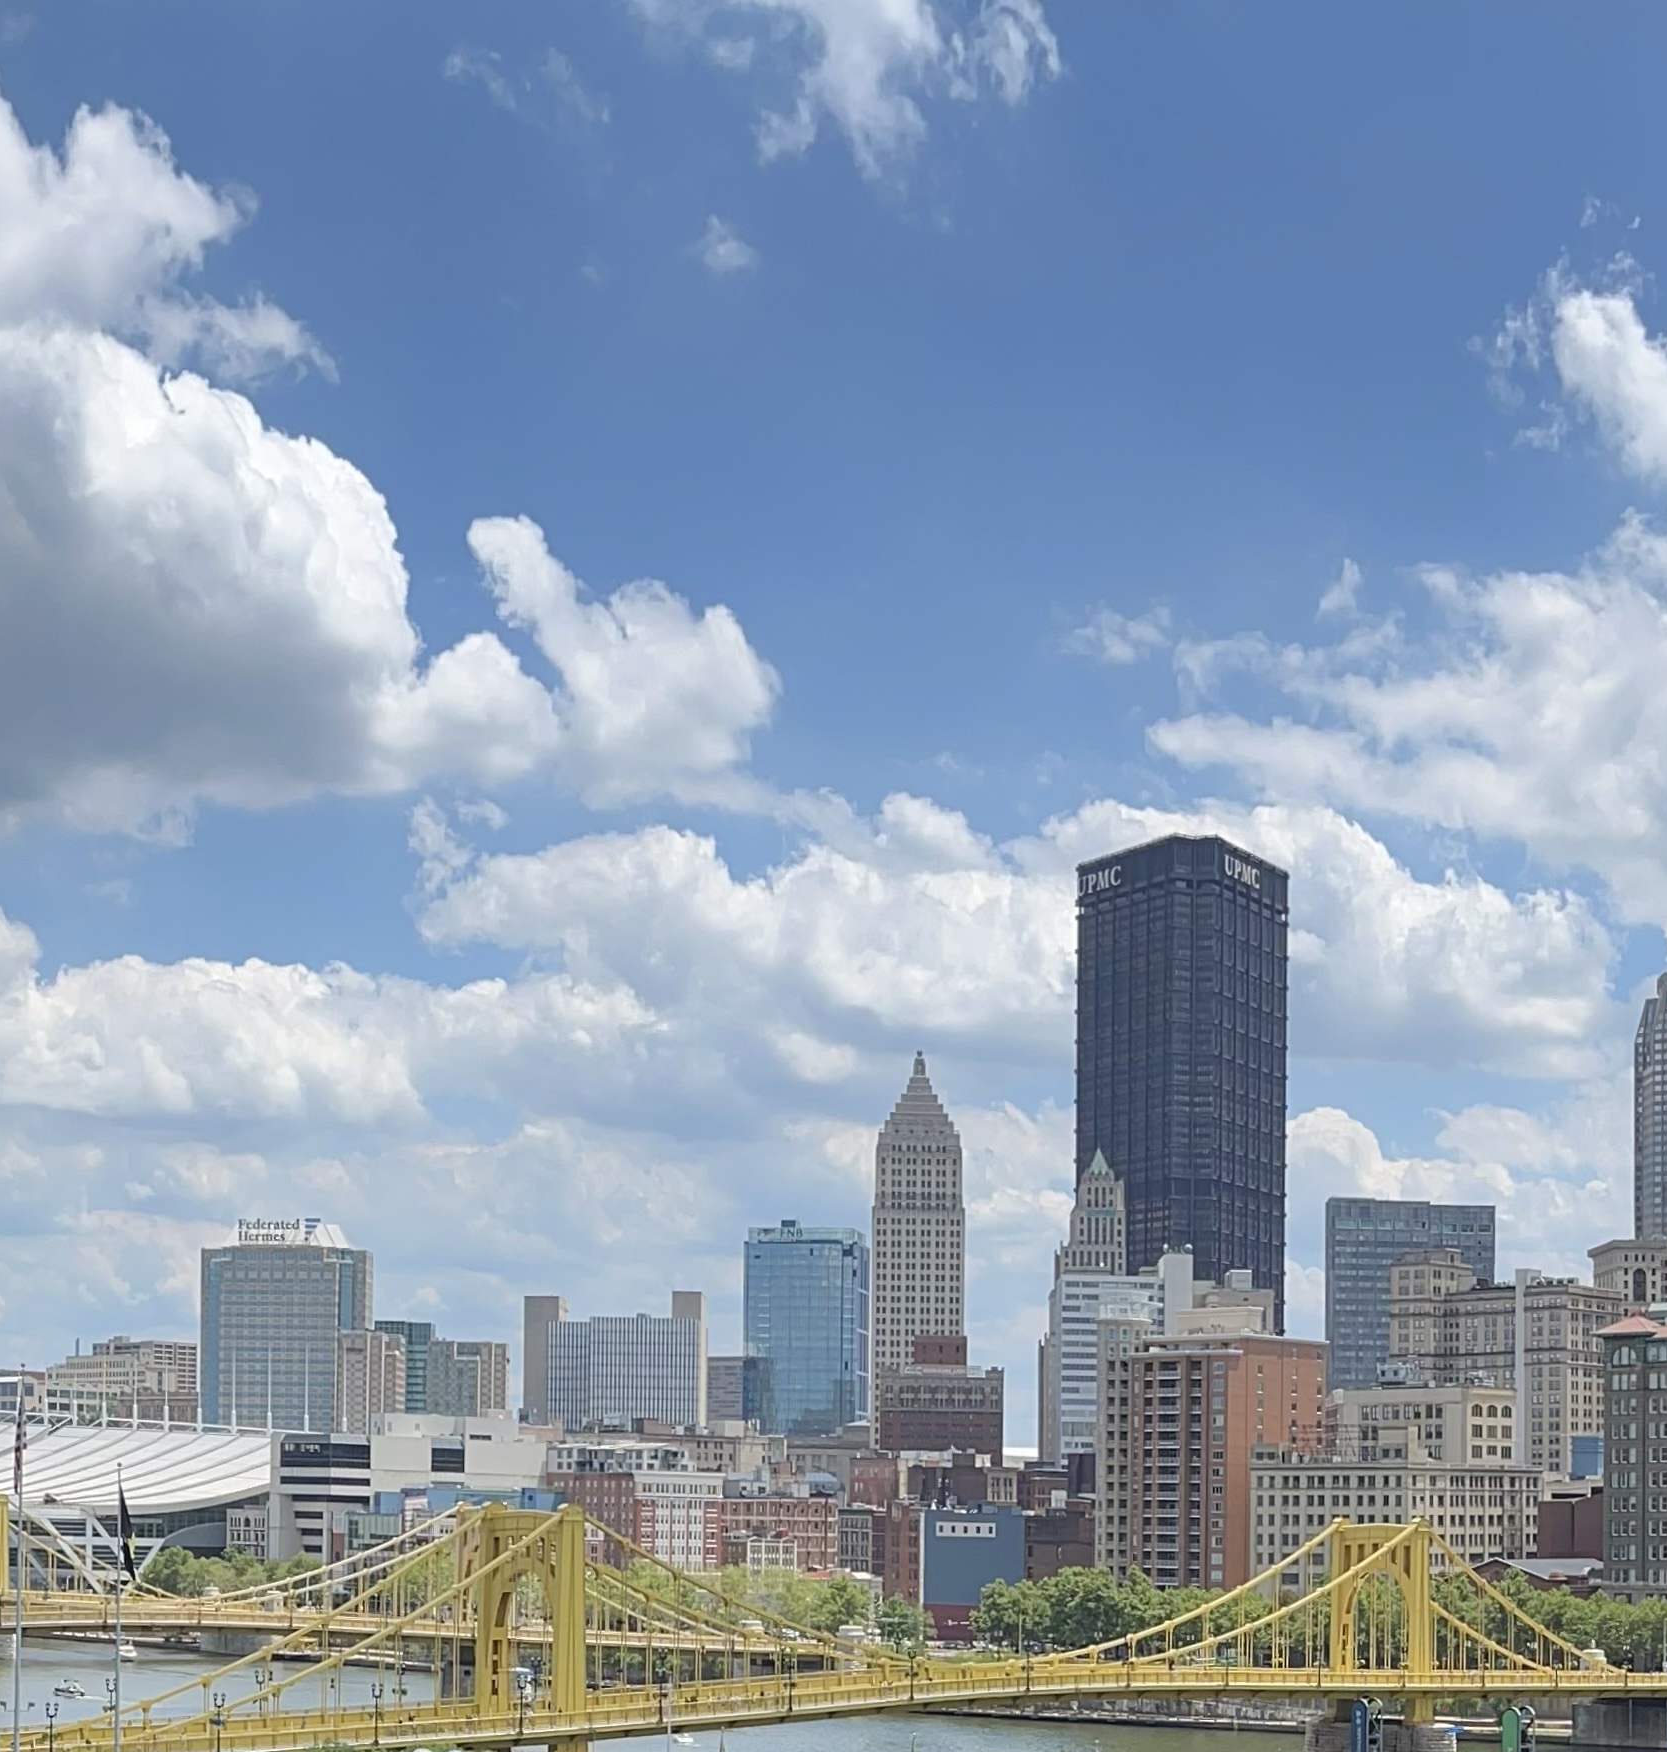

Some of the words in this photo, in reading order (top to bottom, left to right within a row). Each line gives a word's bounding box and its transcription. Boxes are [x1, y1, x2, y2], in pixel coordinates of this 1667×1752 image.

[1078, 866, 1122, 897] UPMC
[1224, 854, 1260, 889] UPMC
[238, 1218, 300, 1230] Federated
[238, 1231, 286, 1241] Hermes
